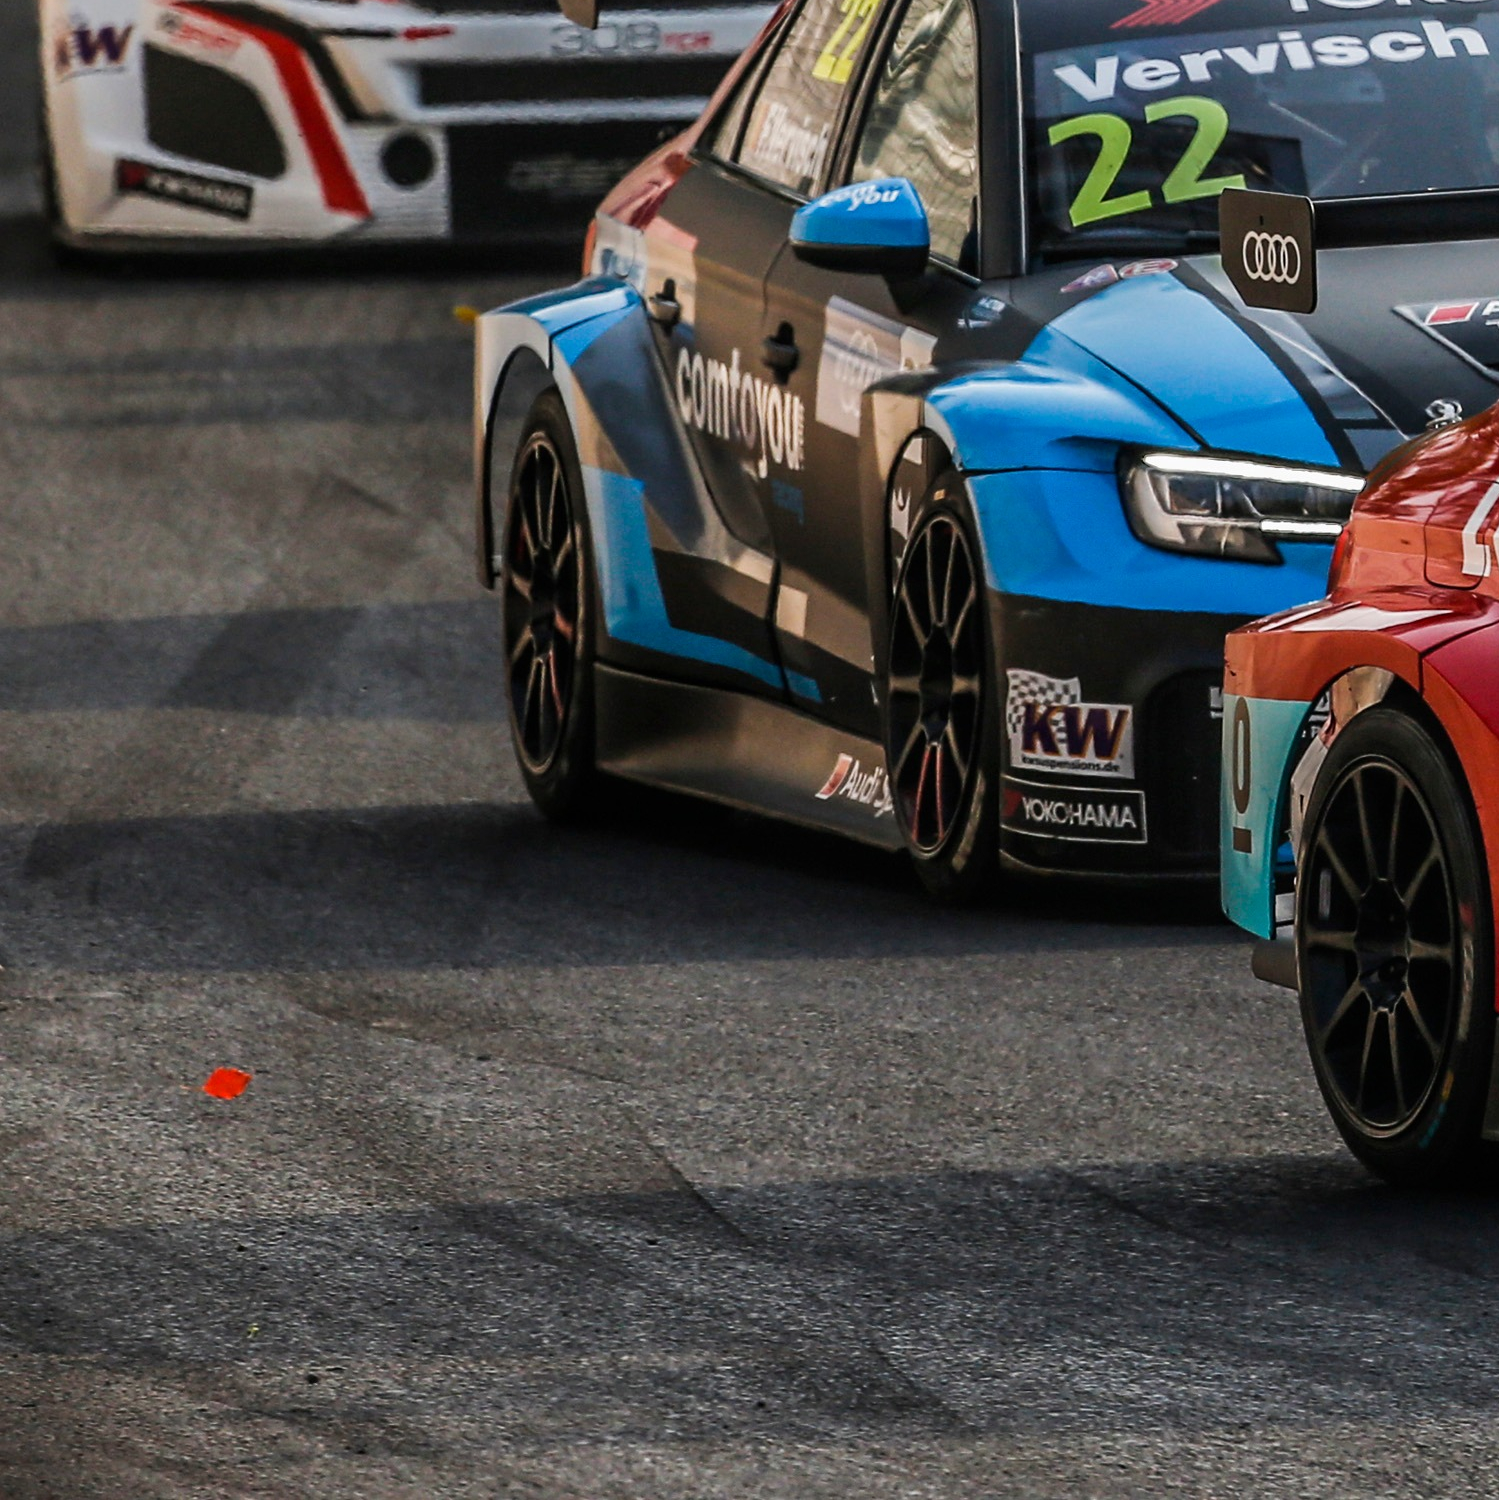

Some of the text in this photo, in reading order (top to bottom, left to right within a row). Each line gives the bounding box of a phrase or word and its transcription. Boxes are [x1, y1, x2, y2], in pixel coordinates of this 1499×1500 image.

[1053, 19, 1490, 102] Vervisch
[1047, 95, 1246, 228] 22
[677, 346, 801, 479] comtoyou
[1021, 701, 1130, 761] KW
[1021, 796, 1137, 829] YOKOHAMA
